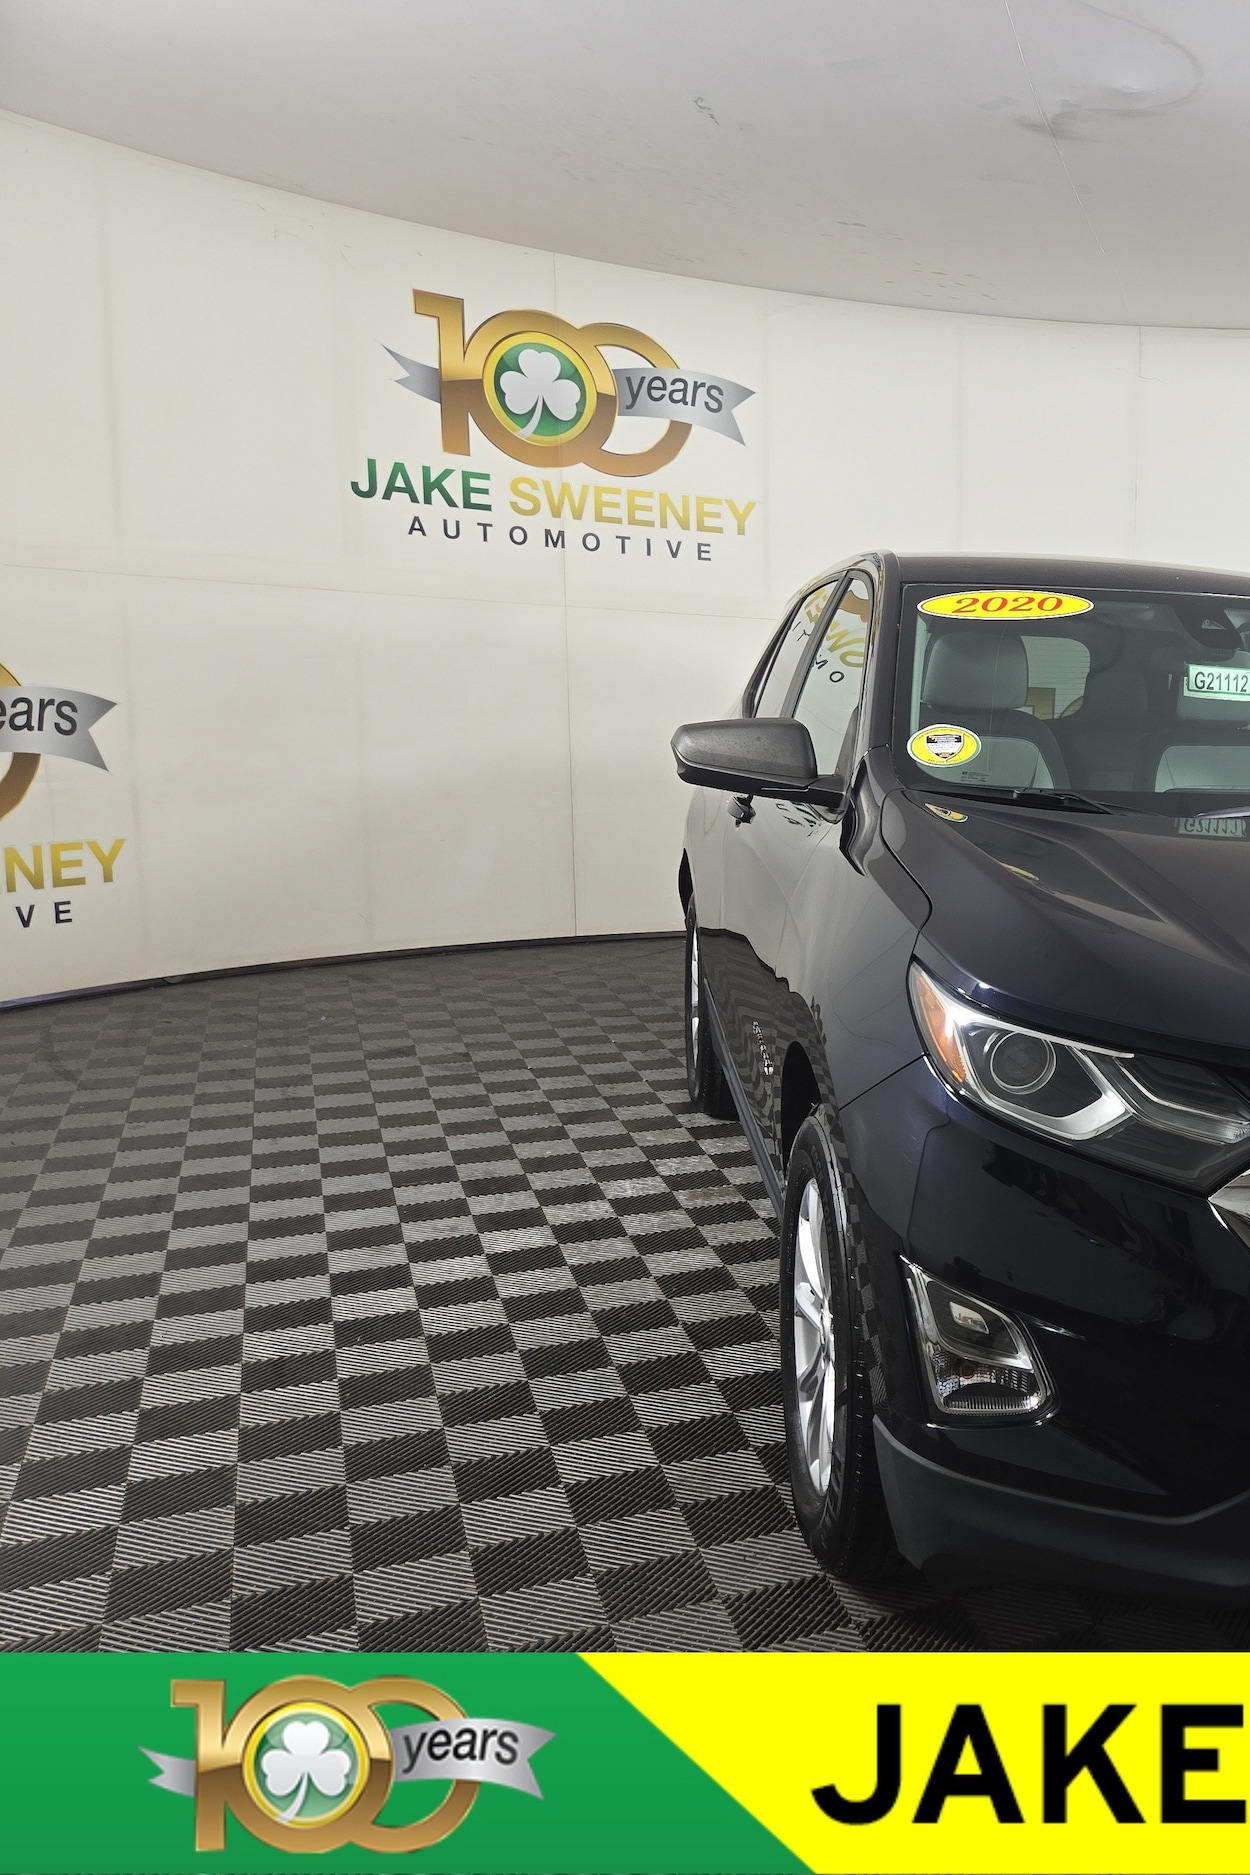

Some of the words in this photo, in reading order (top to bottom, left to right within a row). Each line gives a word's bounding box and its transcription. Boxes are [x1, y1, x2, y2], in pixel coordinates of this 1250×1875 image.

[412, 288, 692, 477] 100
[625, 376, 724, 413] years
[351, 458, 492, 512] JAKE
[509, 477, 757, 536] SWEENEY
[408, 516, 712, 562] AUTOMOTIVE
[951, 596, 1063, 614] 2020
[1194, 672, 1249, 693] G21112
[0, 696, 78, 736] ars
